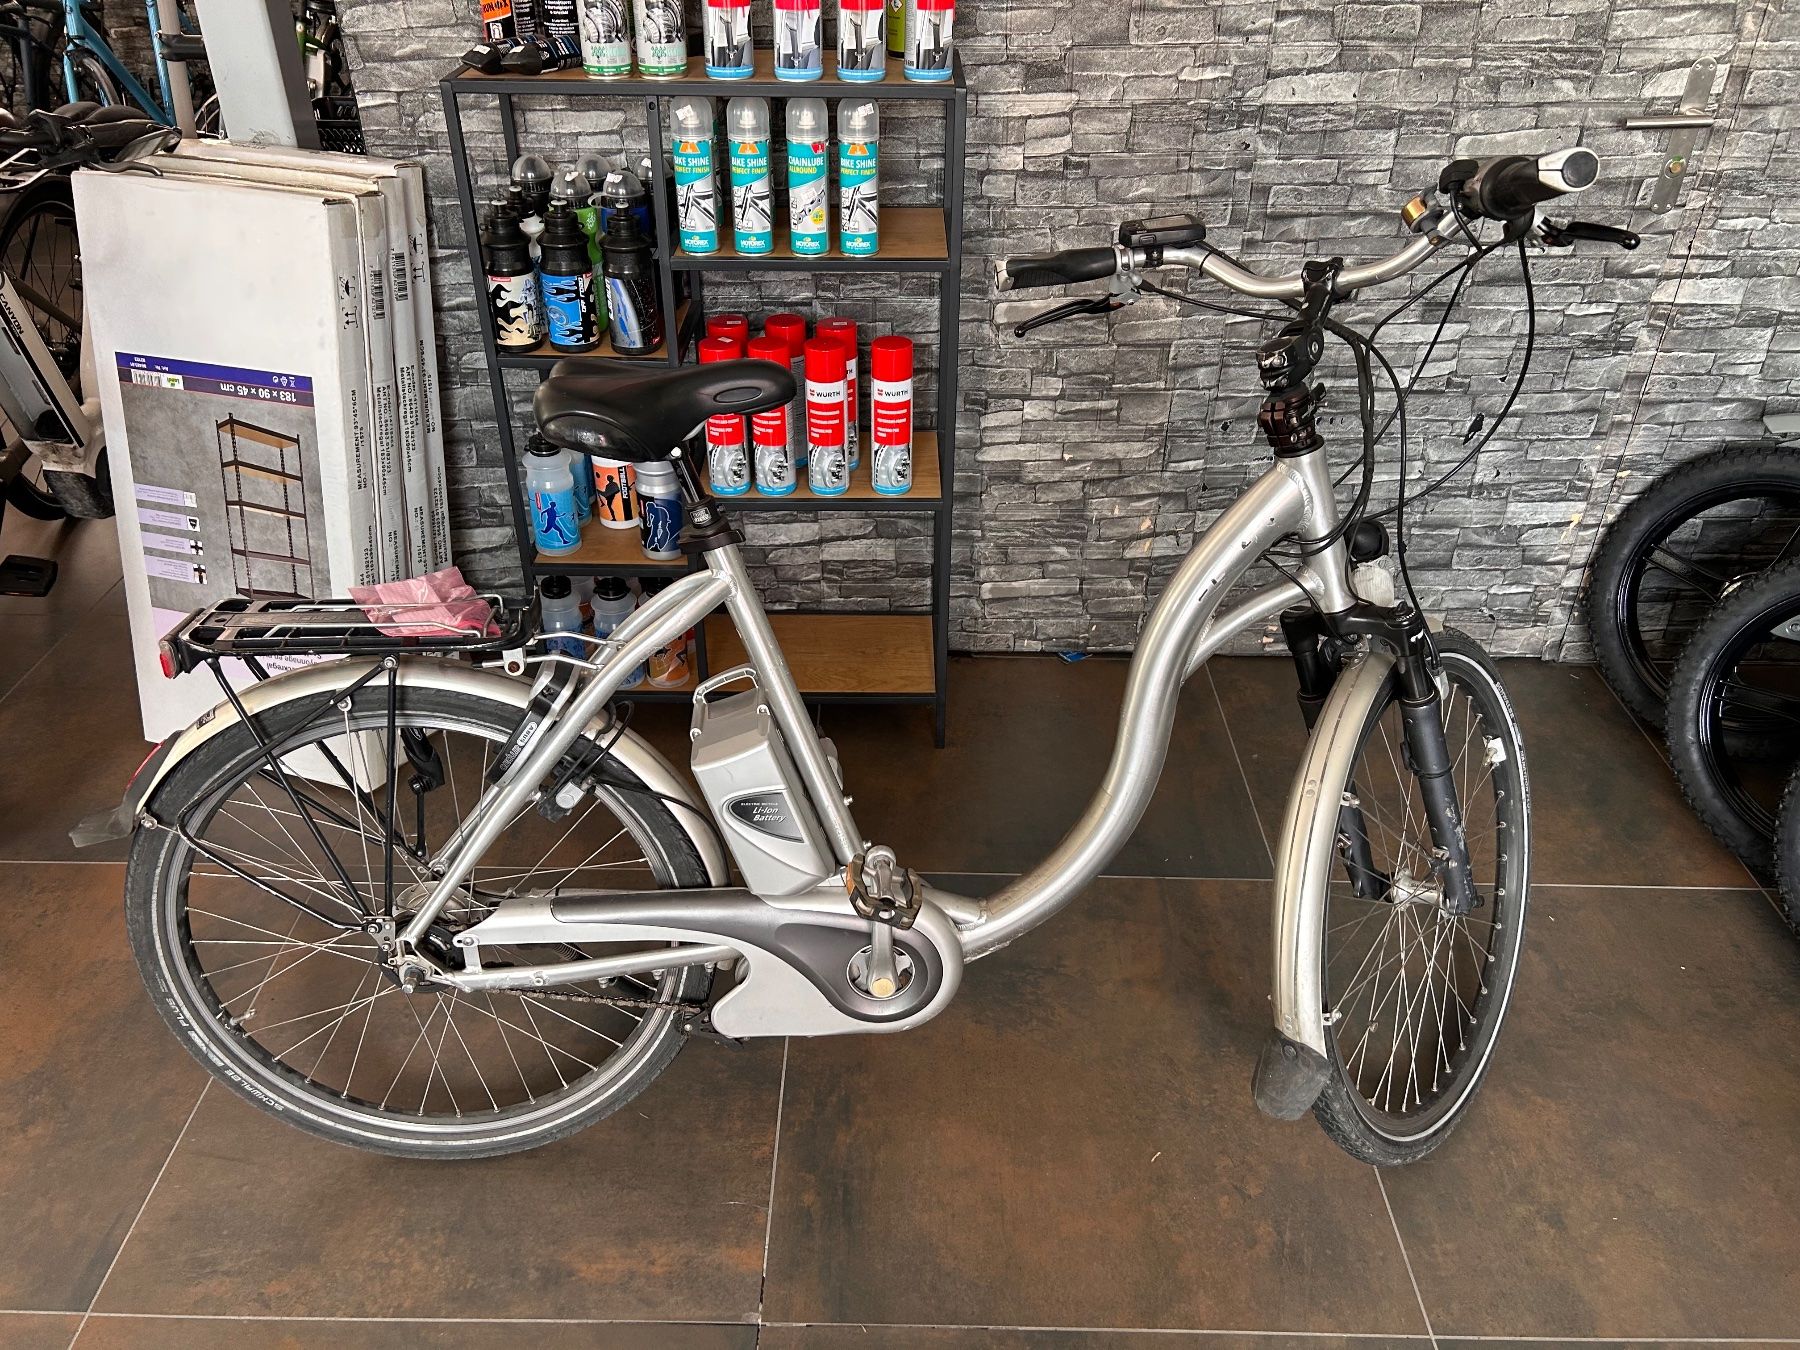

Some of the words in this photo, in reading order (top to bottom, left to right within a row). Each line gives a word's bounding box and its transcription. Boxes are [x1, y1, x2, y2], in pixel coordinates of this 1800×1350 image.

[687, 156, 710, 167] SHINE
[747, 156, 767, 167] SHINE
[788, 156, 824, 167] CHAINLUBE
[840, 157, 855, 168] BIKE
[856, 157, 876, 168] SHINE
[788, 166, 817, 175] ALLROUND
[0, 292, 25, 335] CANYON
[220, 382, 236, 393] cm
[236, 384, 249, 396] 45
[258, 387, 271, 399] 90
[279, 390, 298, 403] 183
[753, 814, 787, 824] Battery
[165, 997, 191, 1028] PLUS
[224, 1068, 286, 1112] SCHWALBE
